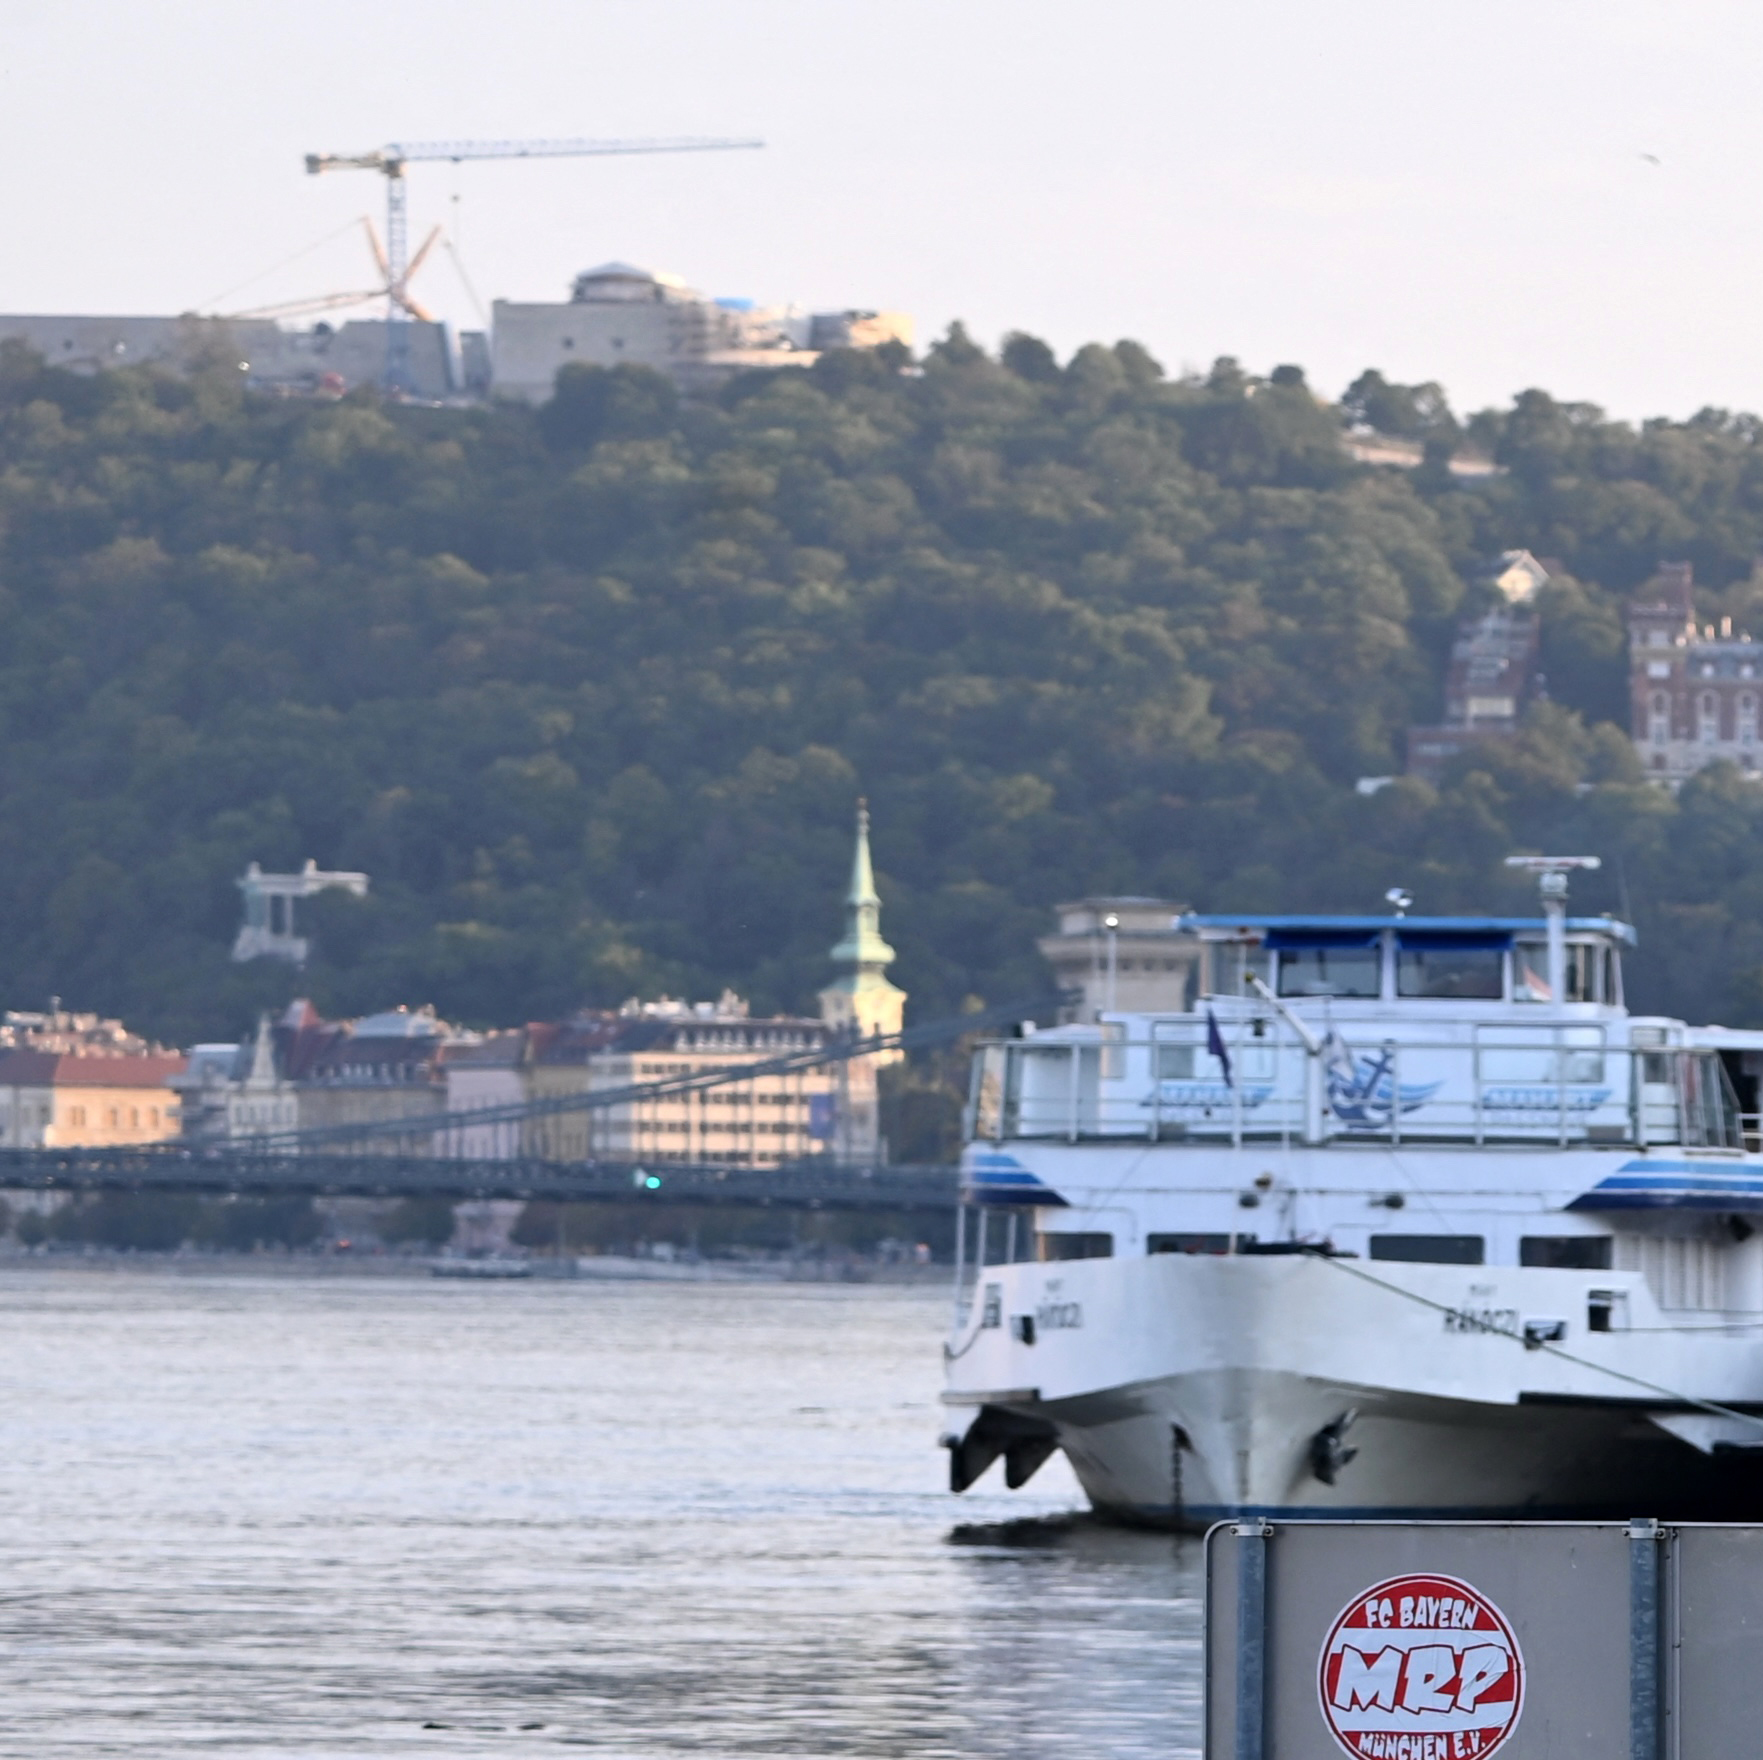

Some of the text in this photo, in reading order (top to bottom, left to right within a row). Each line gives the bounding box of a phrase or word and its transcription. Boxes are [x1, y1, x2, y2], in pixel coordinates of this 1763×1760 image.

[1365, 1596, 1481, 1630] FC BAYERN
[1332, 1643, 1509, 1715] MRP
[1452, 1730, 1487, 1760] E.V.
